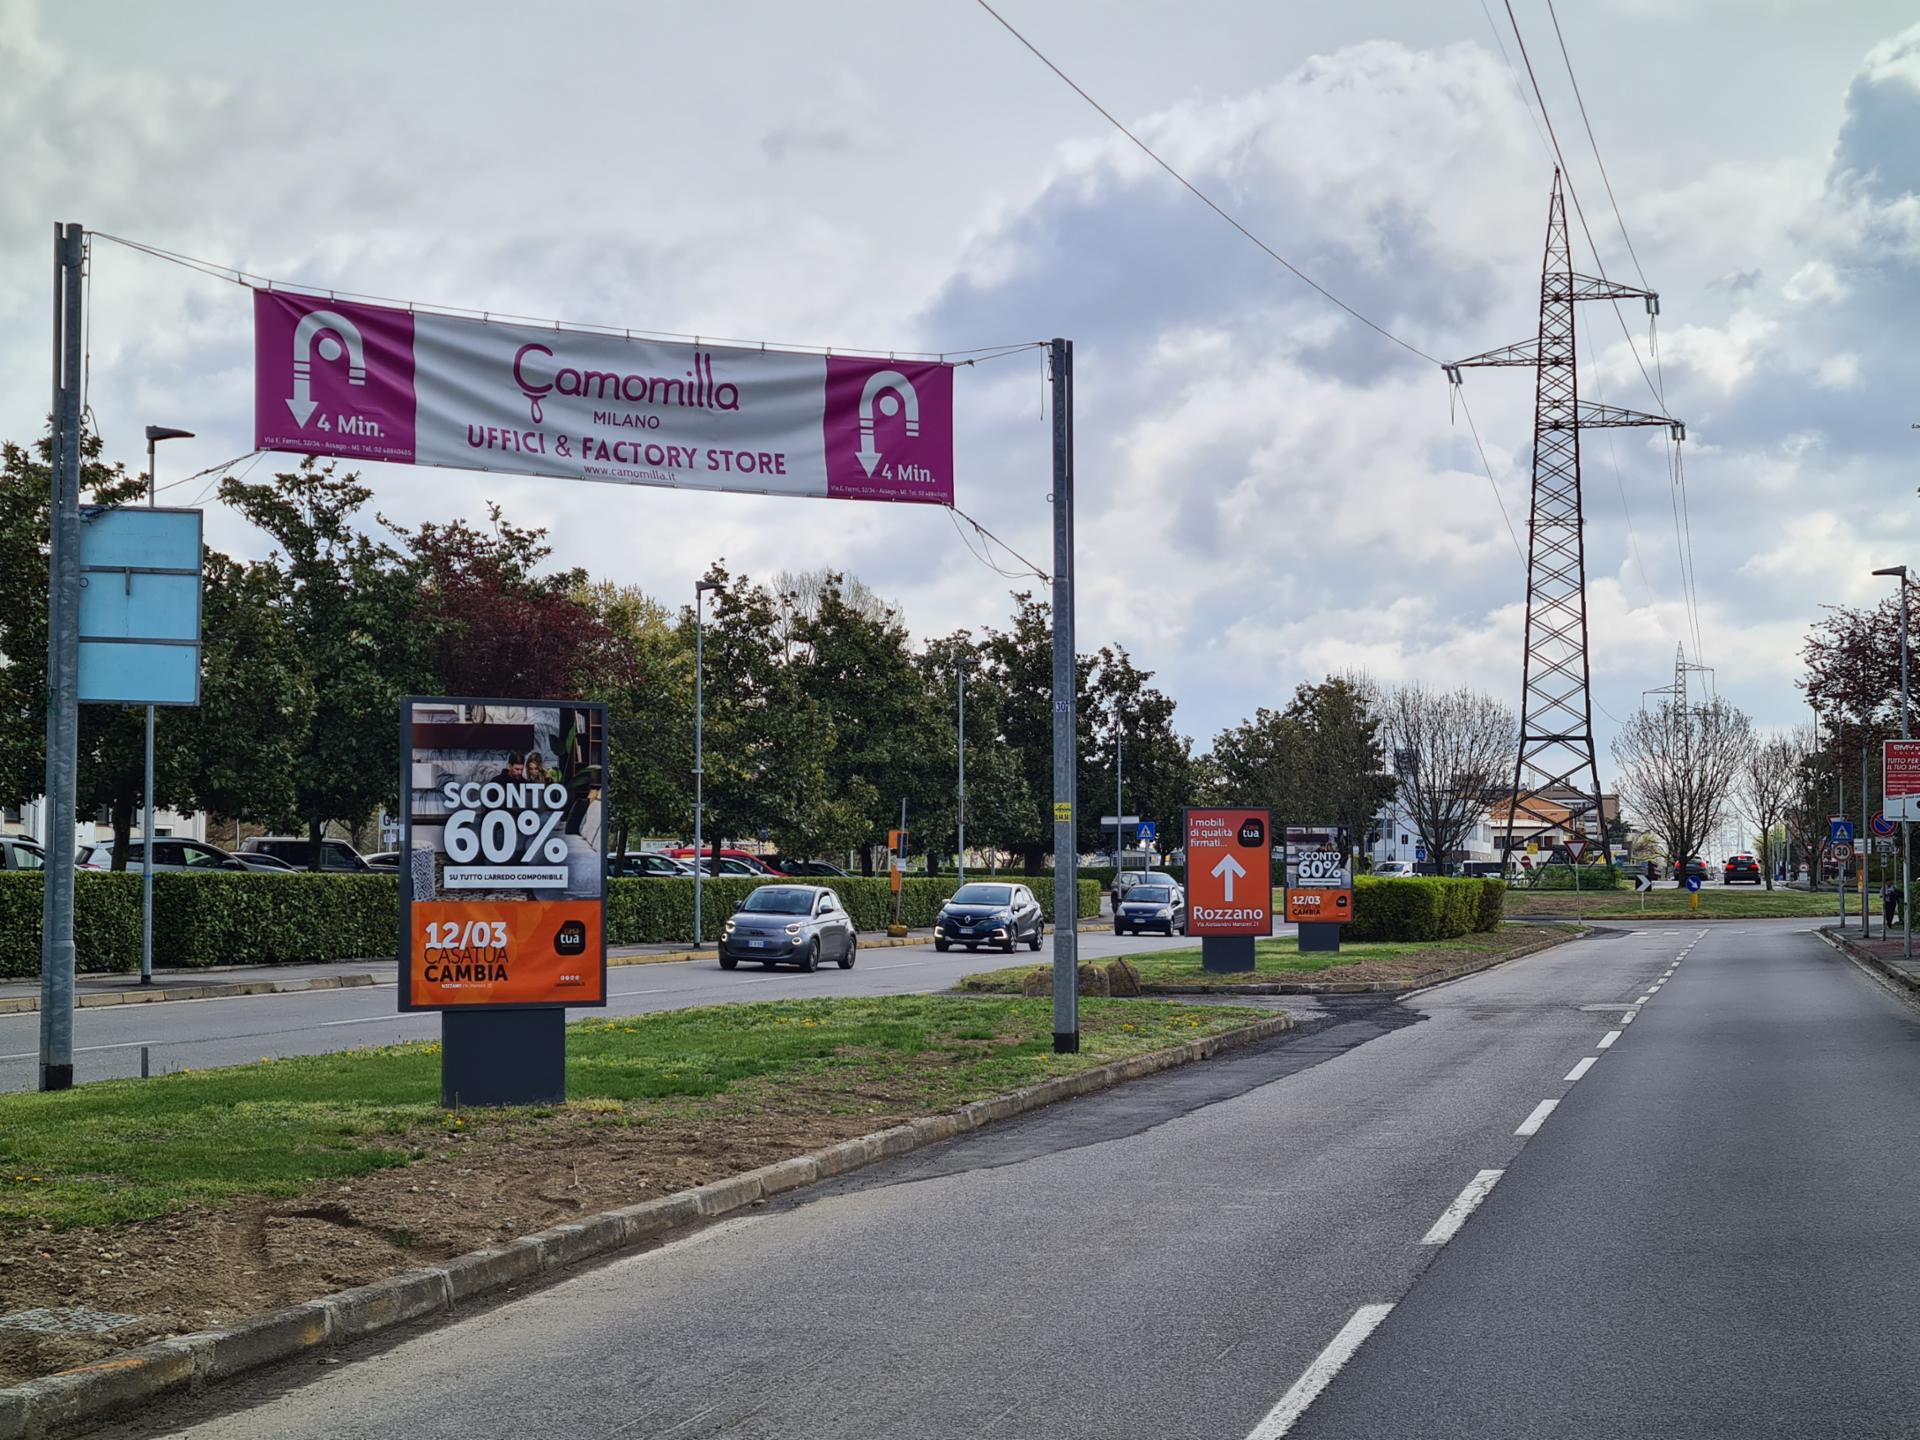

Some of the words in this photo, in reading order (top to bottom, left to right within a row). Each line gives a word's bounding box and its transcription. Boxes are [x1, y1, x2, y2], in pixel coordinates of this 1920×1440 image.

[513, 342, 739, 424] Camomilla
[317, 413, 331, 432] 4
[338, 414, 385, 438] Min.
[593, 411, 660, 430] MILANO
[467, 424, 546, 455] UFFICI
[555, 434, 573, 458] &
[582, 436, 698, 469] FACTORY
[706, 449, 787, 476] STORE
[583, 464, 676, 482] www.camomilla.it
[881, 463, 893, 480] 4
[897, 464, 936, 484] Min.
[443, 781, 568, 809] SCONTO
[1195, 818, 1225, 827] mobili
[443, 809, 569, 863] 60%
[1190, 829, 1198, 837] di
[1242, 829, 1260, 838] tua
[1298, 851, 1342, 861] SCONTO
[1836, 846, 1849, 857] 30
[449, 873, 458, 881] SU
[1298, 860, 1342, 878] 60%
[1292, 895, 1321, 905] 12/03
[1193, 906, 1264, 920] Rozzano
[1292, 908, 1321, 916] CAMBIA
[425, 921, 509, 950] 12/03
[560, 933, 580, 944] tua
[424, 948, 509, 965] CASATUA
[424, 964, 508, 982] CAMBIA
